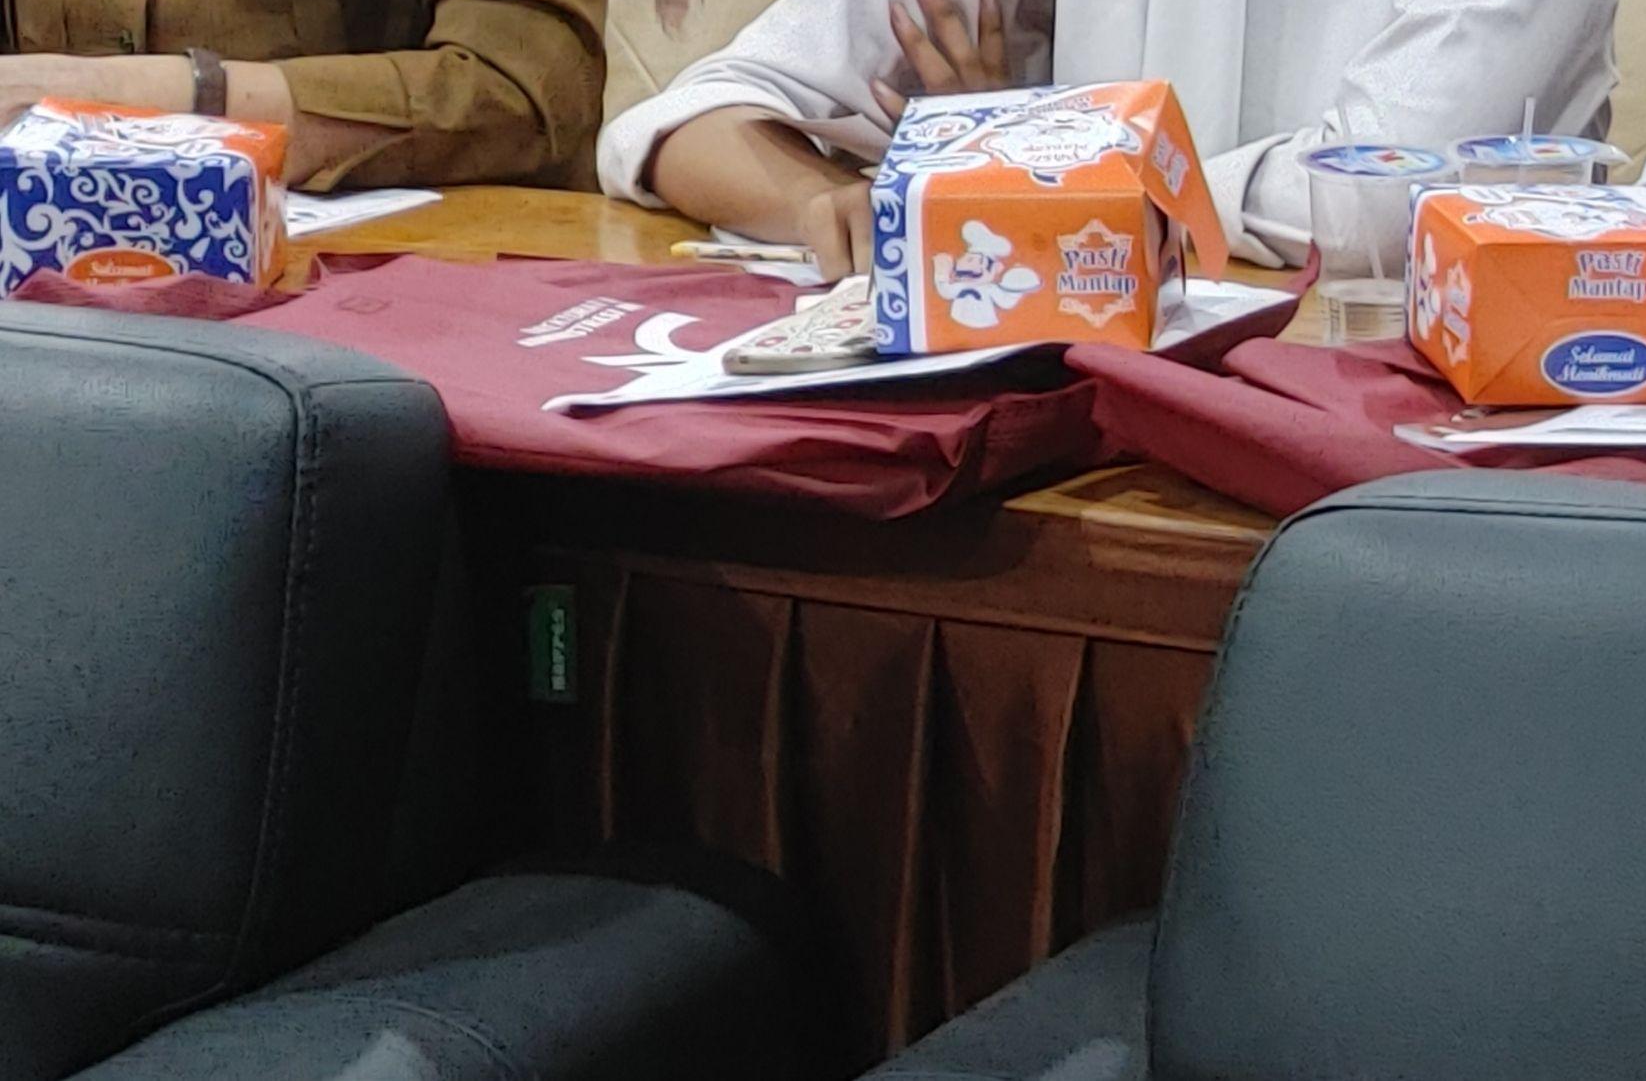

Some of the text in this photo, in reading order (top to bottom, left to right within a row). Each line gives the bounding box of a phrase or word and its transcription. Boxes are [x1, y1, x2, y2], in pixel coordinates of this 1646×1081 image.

[1063, 247, 1129, 269] Pasti
[1577, 250, 1645, 275] Pasti
[1058, 273, 1137, 296] Mantap
